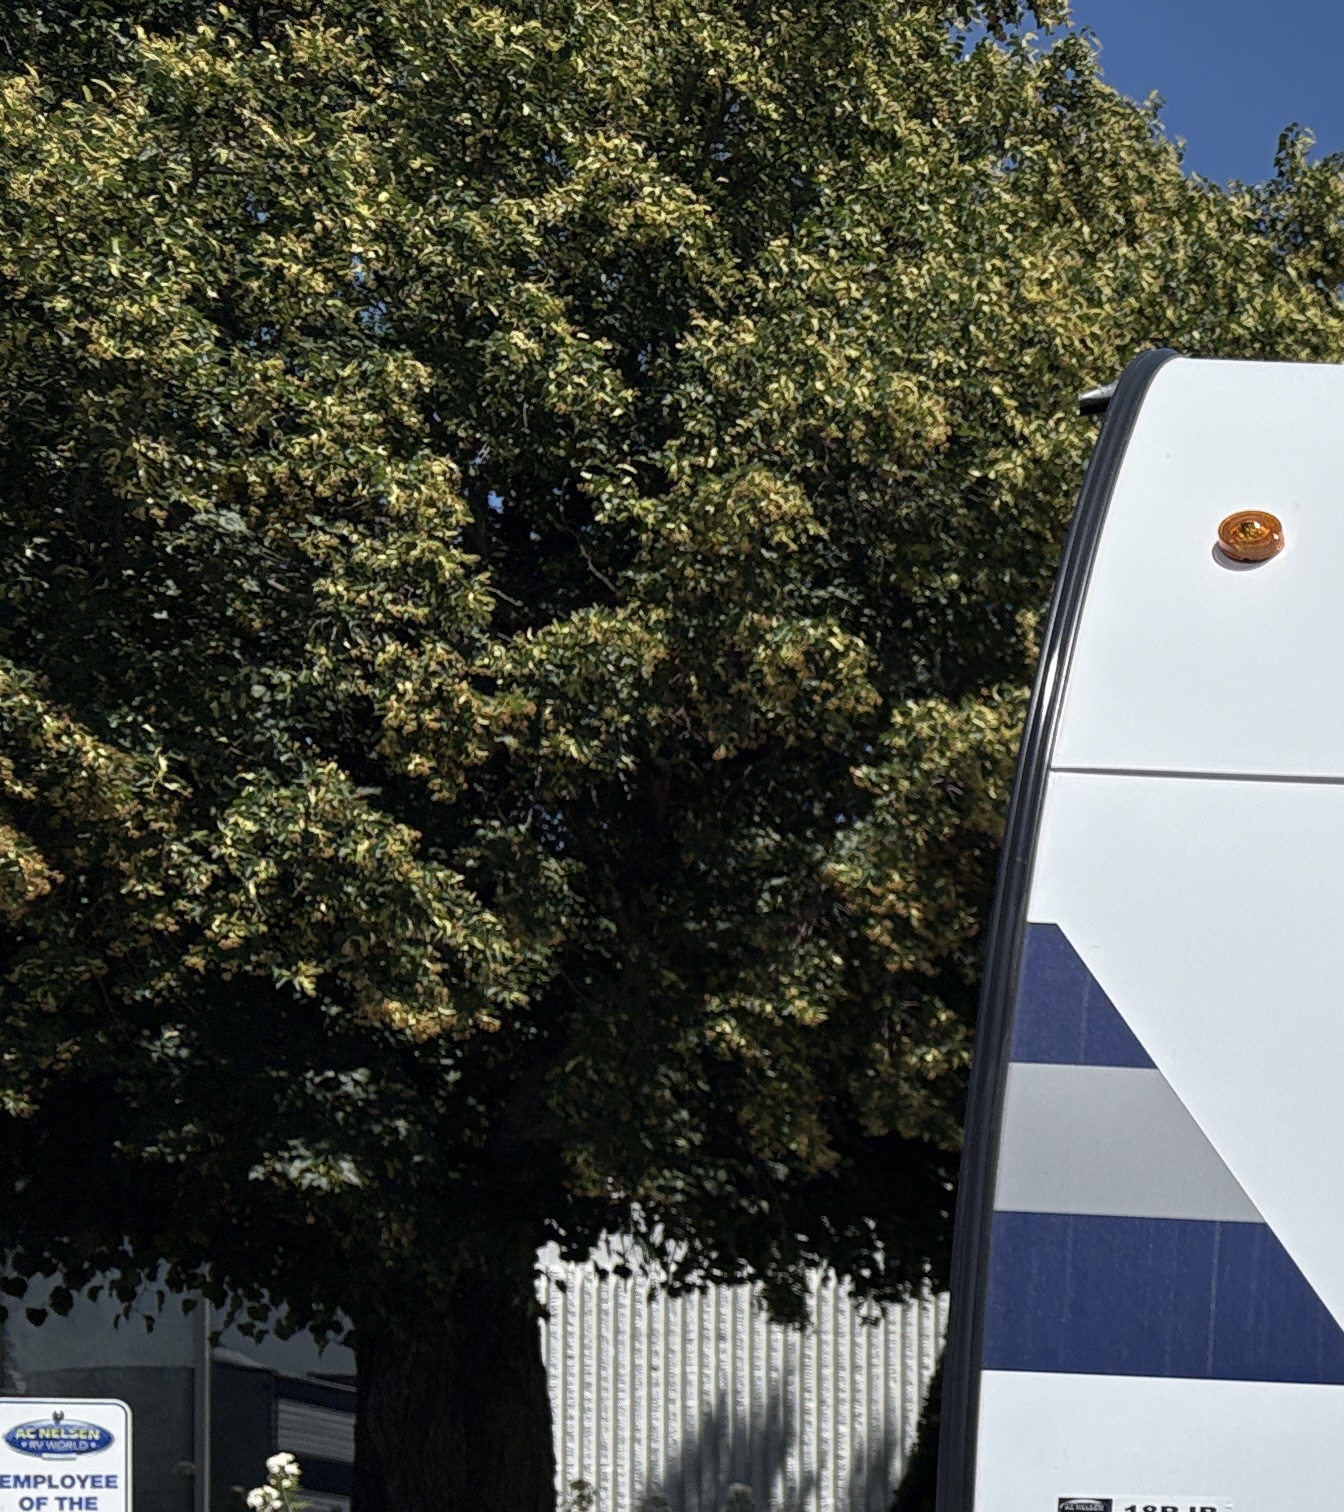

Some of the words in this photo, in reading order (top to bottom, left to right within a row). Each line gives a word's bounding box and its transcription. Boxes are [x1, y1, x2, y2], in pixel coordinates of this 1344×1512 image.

[15, 1428, 37, 1441] AC
[39, 1428, 101, 1441] NELSEN
[29, 1440, 44, 1450] RV
[45, 1441, 89, 1451] WORLD
[0, 1474, 118, 1489] EMPLOYEE
[19, 1496, 48, 1511] OF
[54, 1496, 98, 1511] THE
